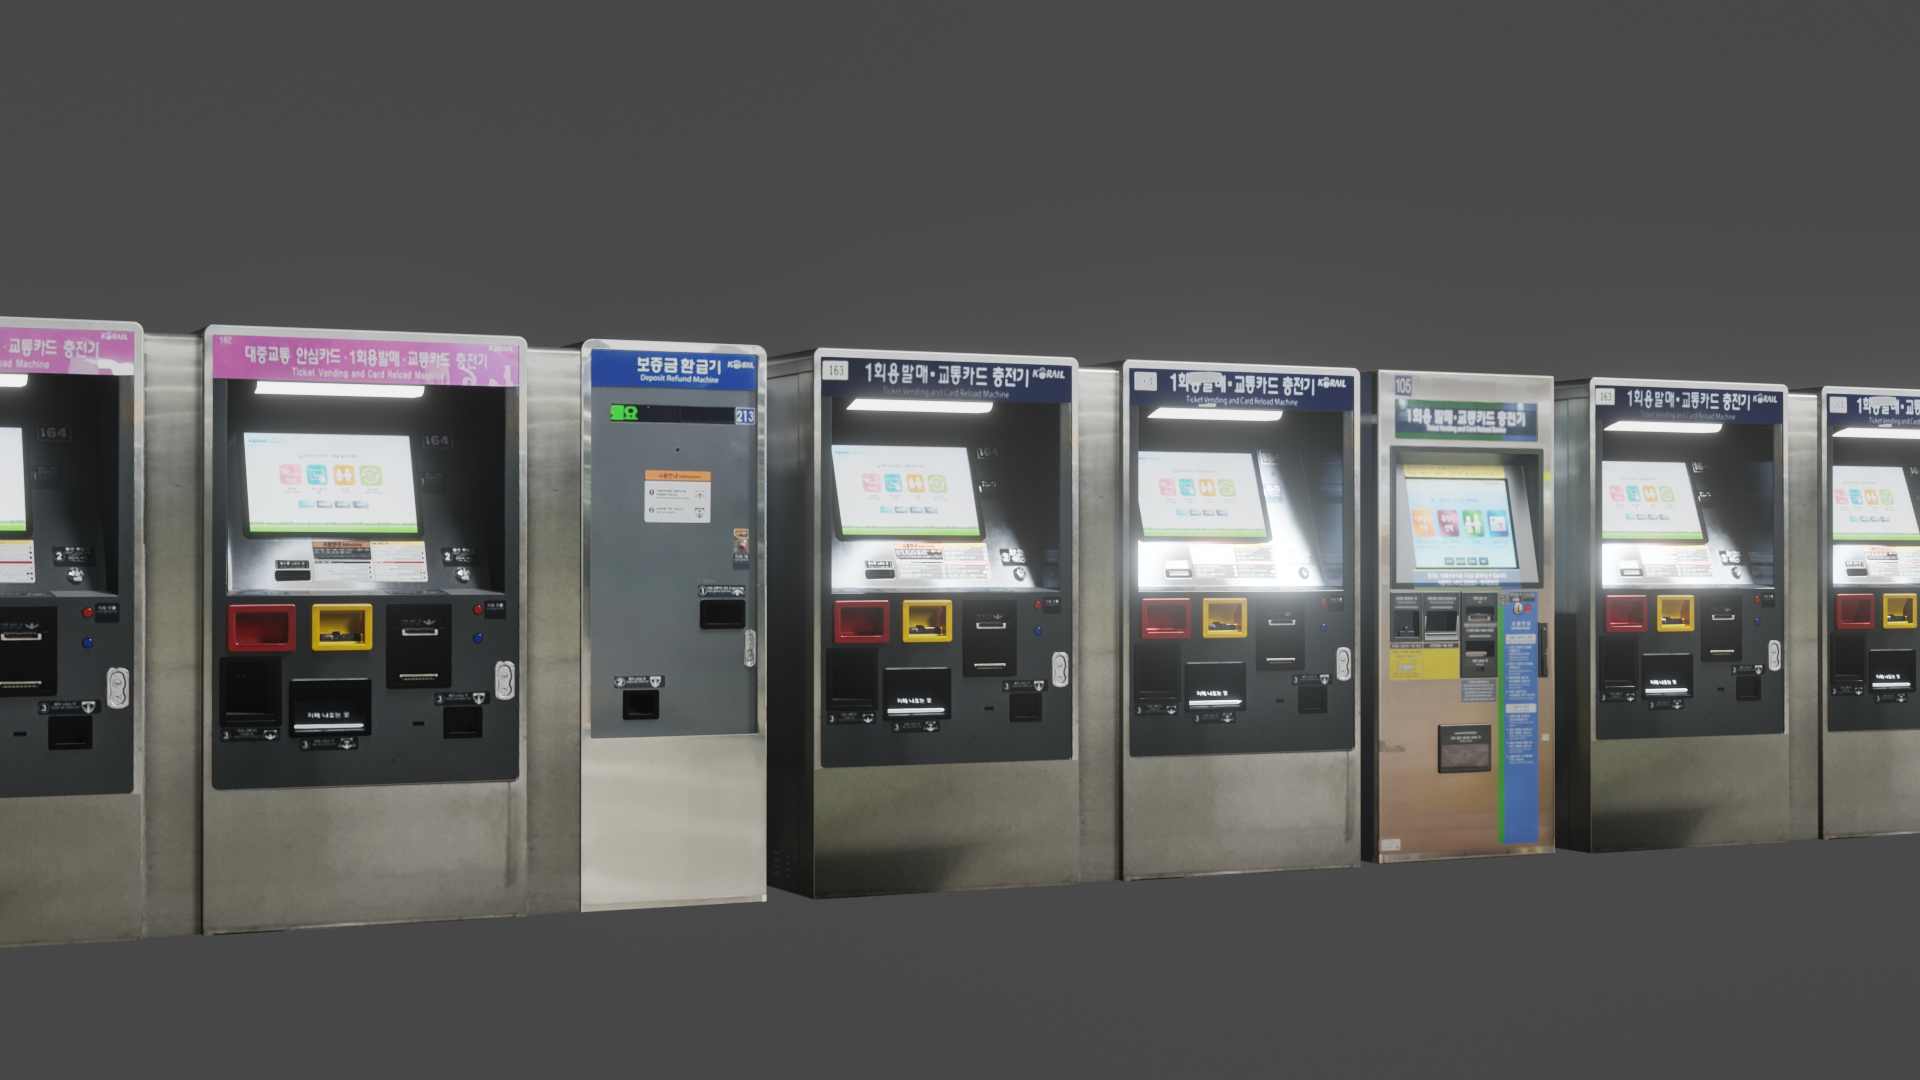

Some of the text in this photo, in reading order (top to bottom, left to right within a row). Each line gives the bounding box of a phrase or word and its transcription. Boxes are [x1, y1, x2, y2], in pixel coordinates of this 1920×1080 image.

[100, 331, 129, 341] KORAIL
[219, 336, 232, 345] 162
[63, 339, 100, 358] 충전기
[244, 345, 291, 365] 대중교통
[456, 352, 488, 370] 충전기
[16, 359, 50, 370] Machine
[637, 356, 722, 375] 보증금 환급기
[829, 365, 844, 376] 163
[292, 367, 316, 377] Ticket
[318, 368, 349, 379] Vending
[351, 369, 365, 379] and
[367, 369, 385, 379] Card
[387, 370, 412, 380] Reload
[640, 374, 719, 384] Deposit Refund Machine
[992, 366, 1029, 388] 충전기
[1032, 367, 1066, 379] KORAIL
[1282, 376, 1315, 396] 충전기
[1317, 376, 1347, 388] KORAIL
[1396, 377, 1411, 394] 105
[882, 386, 1010, 399] Ticket Vending and Card Reload Machine
[1600, 391, 1612, 402] 163
[1753, 393, 1778, 404] KORAIL
[1186, 394, 1299, 407] Ticket Vending and Card Reload Machine
[1723, 392, 1750, 411] 충전기
[736, 409, 755, 423] 213
[1497, 411, 1526, 427] 충전기
[1640, 410, 1655, 419] Ticket
[1655, 410, 1676, 421] Vending
[1715, 413, 1736, 421] Machine
[40, 427, 68, 438] 164
[425, 435, 450, 446] 164
[978, 446, 999, 457] 164
